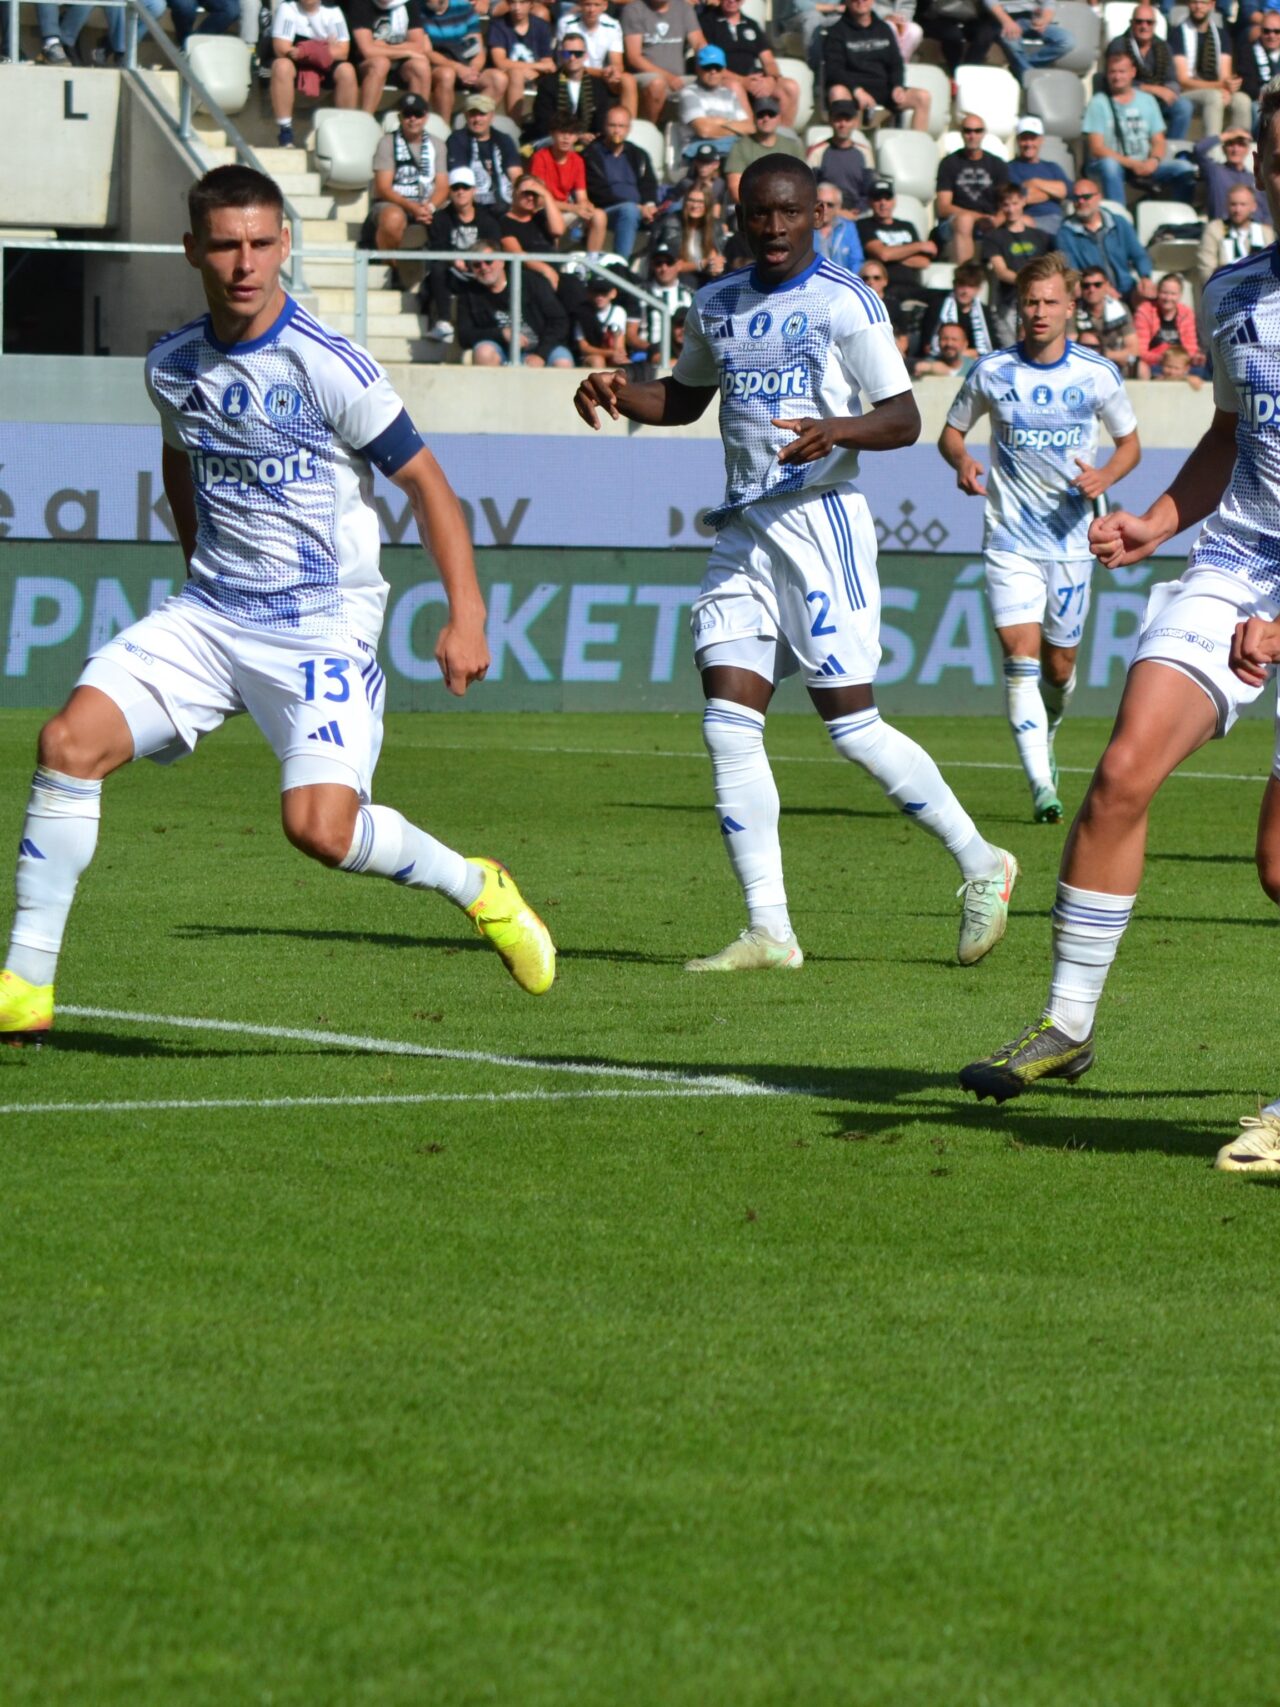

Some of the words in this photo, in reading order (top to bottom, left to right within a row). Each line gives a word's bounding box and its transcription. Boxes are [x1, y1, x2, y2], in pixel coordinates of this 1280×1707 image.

[64, 80, 87, 119] L
[718, 365, 806, 401] ipsport
[806, 590, 837, 638] 2
[1057, 583, 1086, 618] 77
[3, 576, 175, 677] PN
[298, 657, 350, 703] 13
